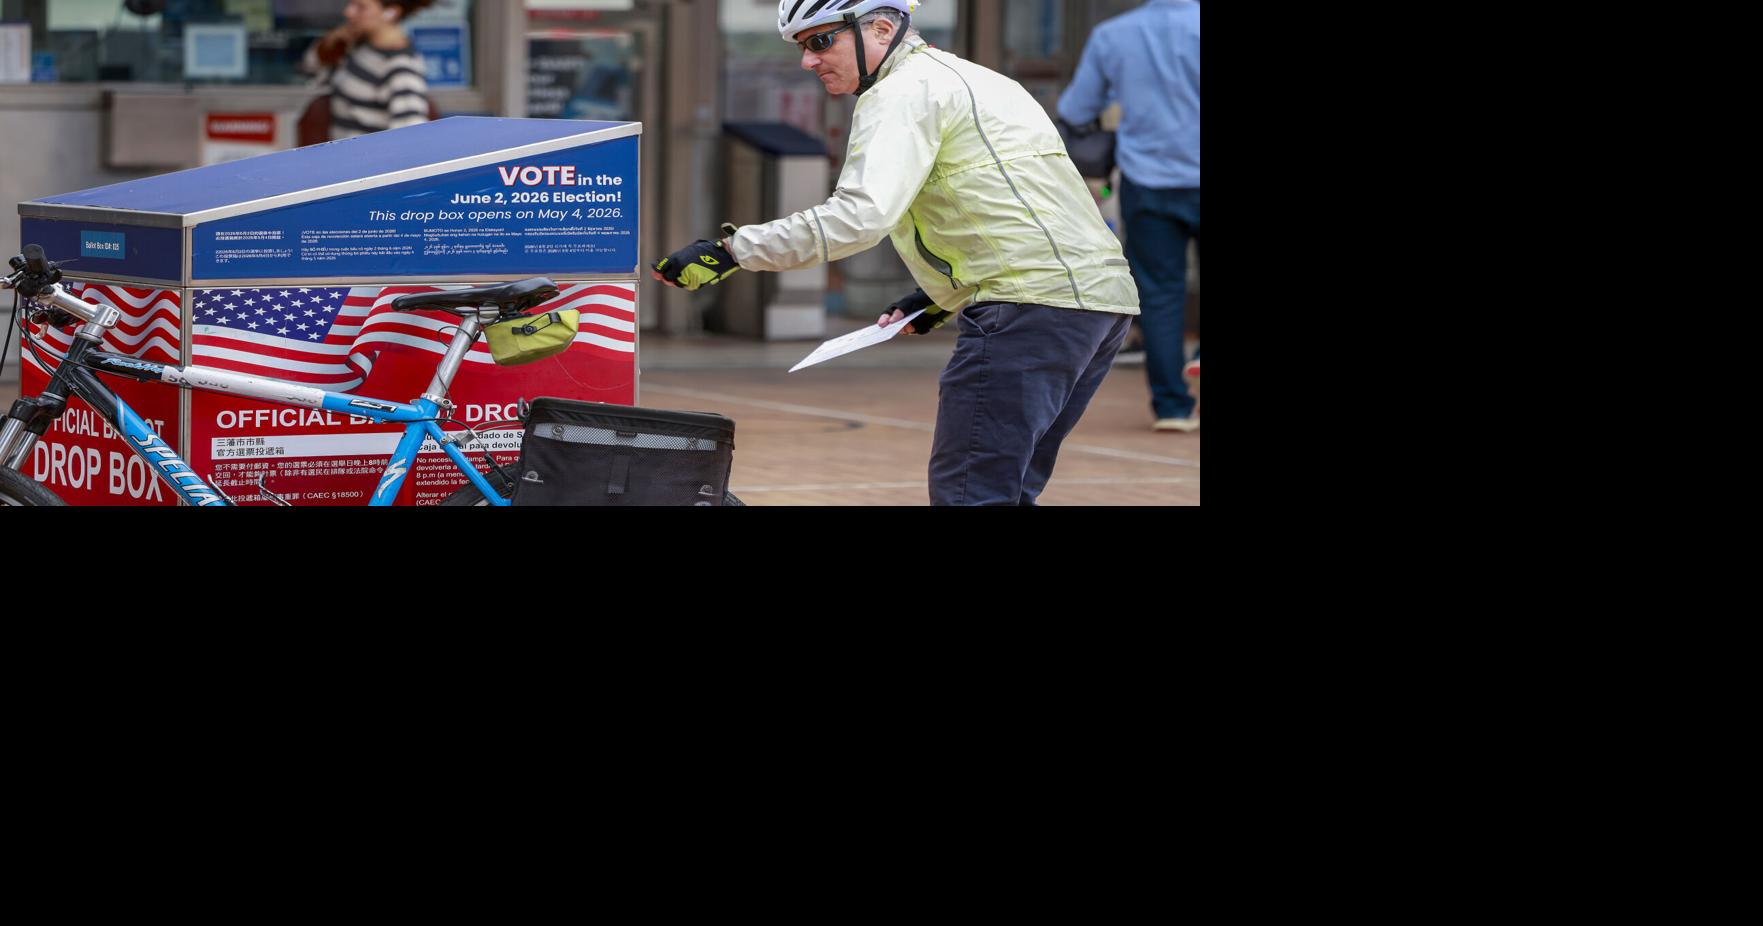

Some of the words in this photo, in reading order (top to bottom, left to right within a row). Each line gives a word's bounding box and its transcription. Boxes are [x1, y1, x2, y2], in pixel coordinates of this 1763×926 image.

[497, 165, 576, 187] VOTE
[578, 174, 592, 186] in
[595, 173, 623, 186] the
[450, 193, 491, 204] June
[494, 192, 507, 205] 2,
[511, 192, 549, 203] 2026
[553, 191, 622, 203] Election!
[369, 210, 396, 221] This
[400, 210, 434, 223] drop
[438, 209, 464, 220] box
[468, 210, 511, 222] opens
[516, 210, 534, 219] on
[538, 208, 568, 221] May
[572, 208, 583, 220] 4,
[587, 207, 623, 218] 2026.
[53, 408, 99, 438] FICIAL
[216, 408, 342, 429] OFFICIAL
[466, 403, 519, 422] DRO
[34, 440, 102, 490] DROP
[109, 450, 163, 502] BOX
